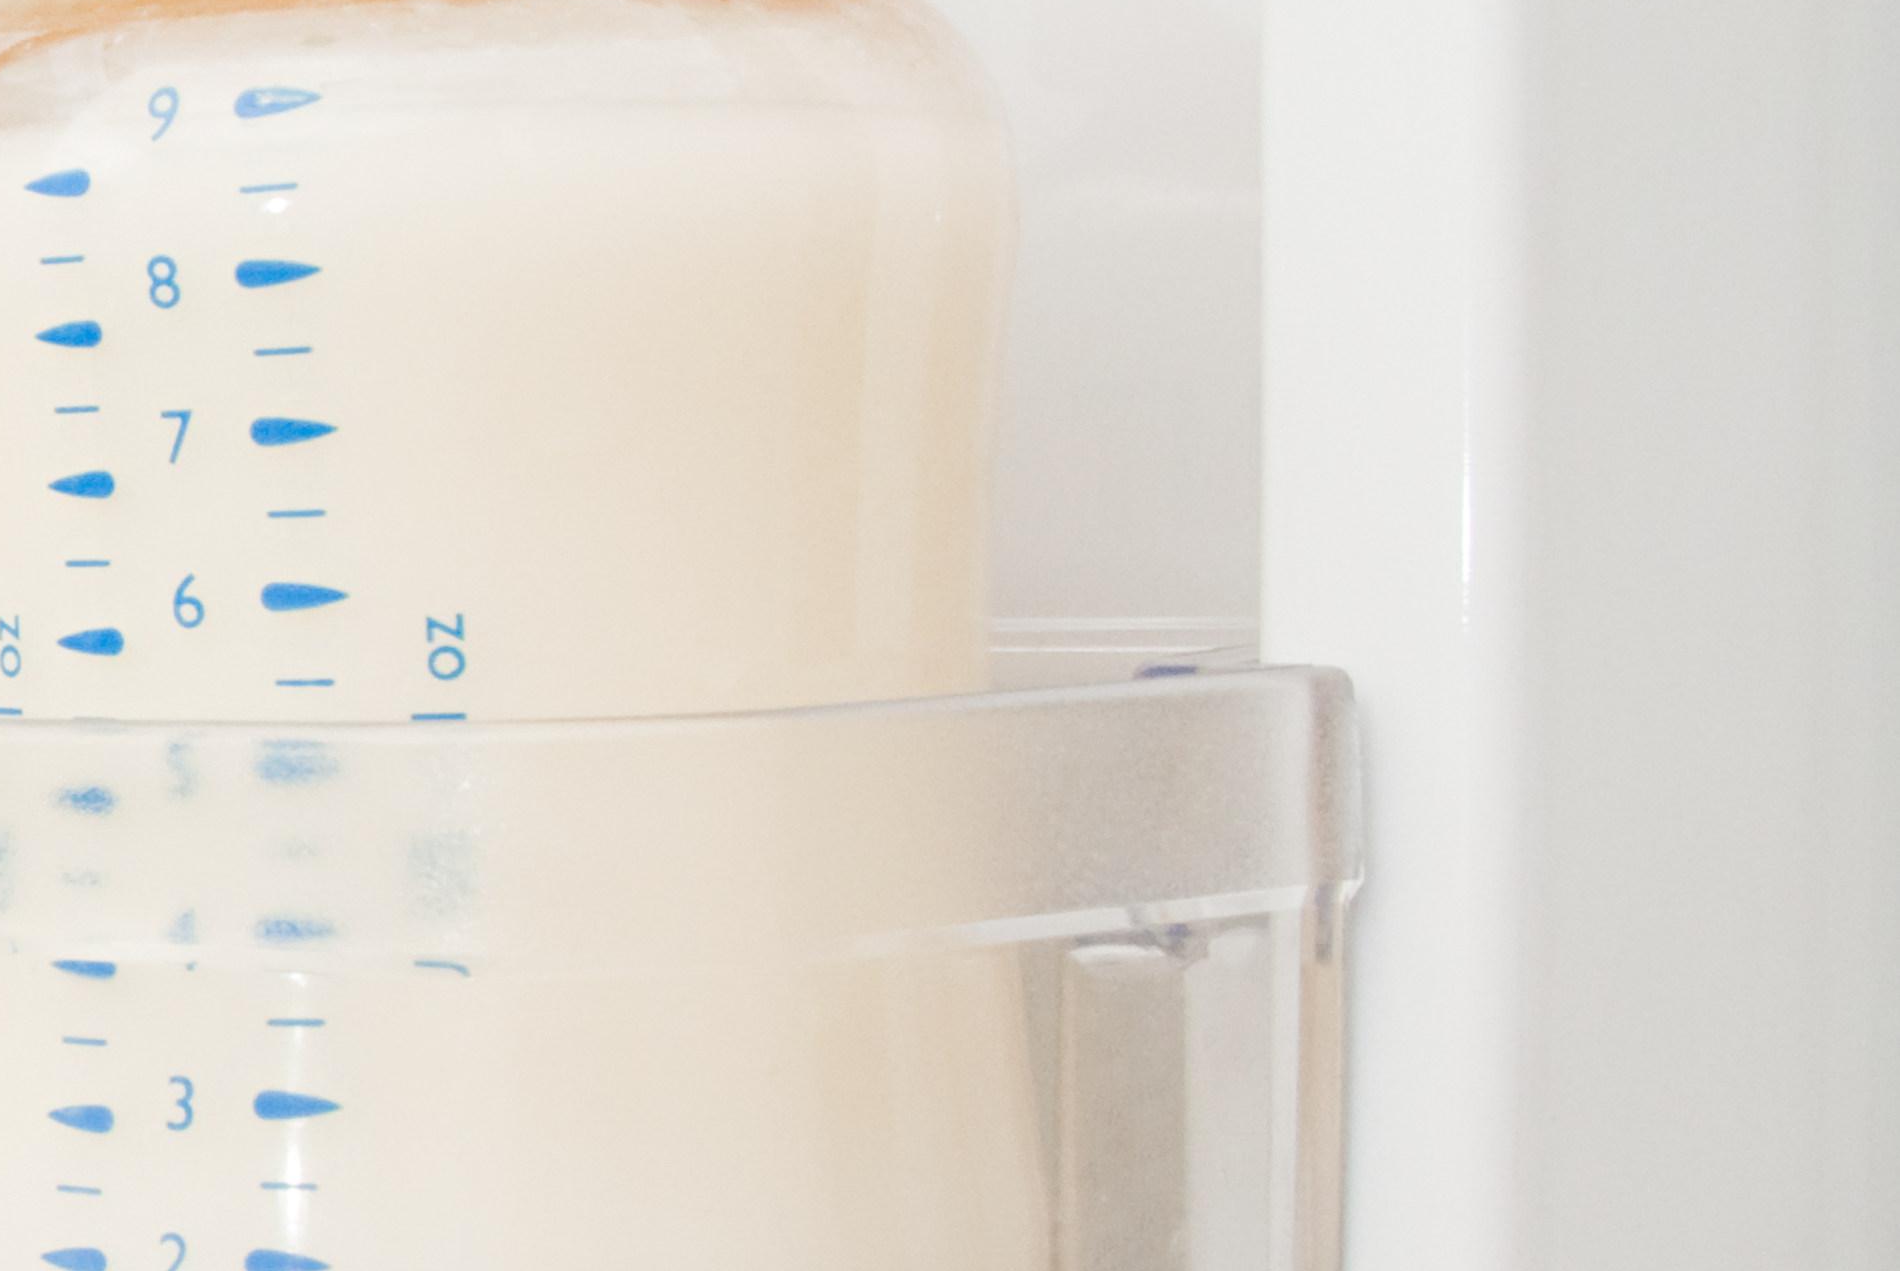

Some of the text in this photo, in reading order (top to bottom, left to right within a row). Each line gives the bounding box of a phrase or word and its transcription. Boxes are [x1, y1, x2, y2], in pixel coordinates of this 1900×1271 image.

[148, 86, 180, 142] 9
[147, 255, 181, 309] 8
[161, 410, 192, 463] 7
[173, 574, 205, 628] 6
[426, 614, 466, 680] oz
[167, 1076, 194, 1131] 3
